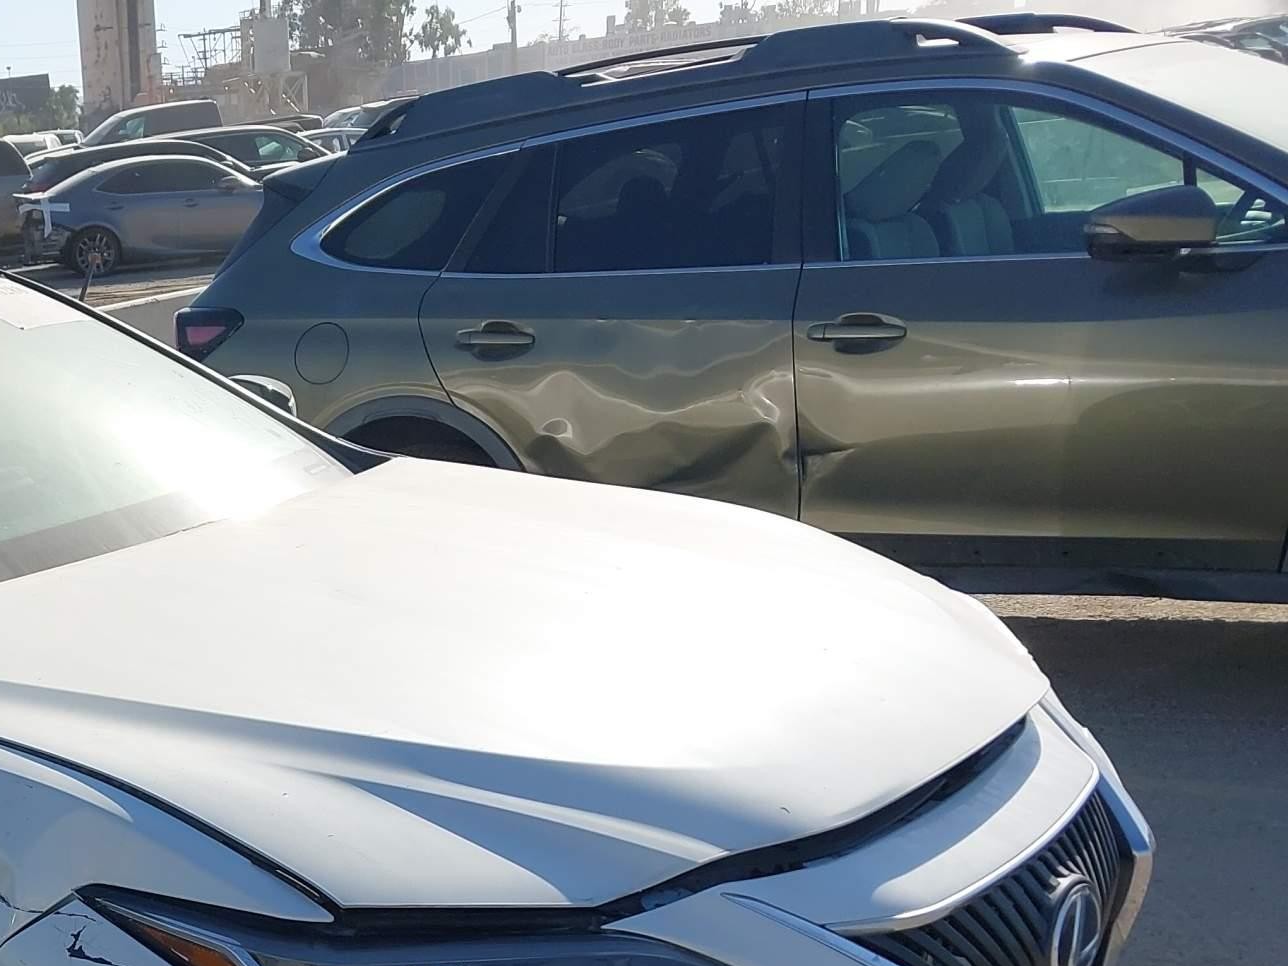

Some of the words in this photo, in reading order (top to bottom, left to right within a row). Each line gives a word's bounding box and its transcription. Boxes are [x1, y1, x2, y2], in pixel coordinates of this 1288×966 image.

[548, 45, 569, 57] AUTO
[572, 41, 601, 53] GLASS
[602, 38, 624, 49] BODY
